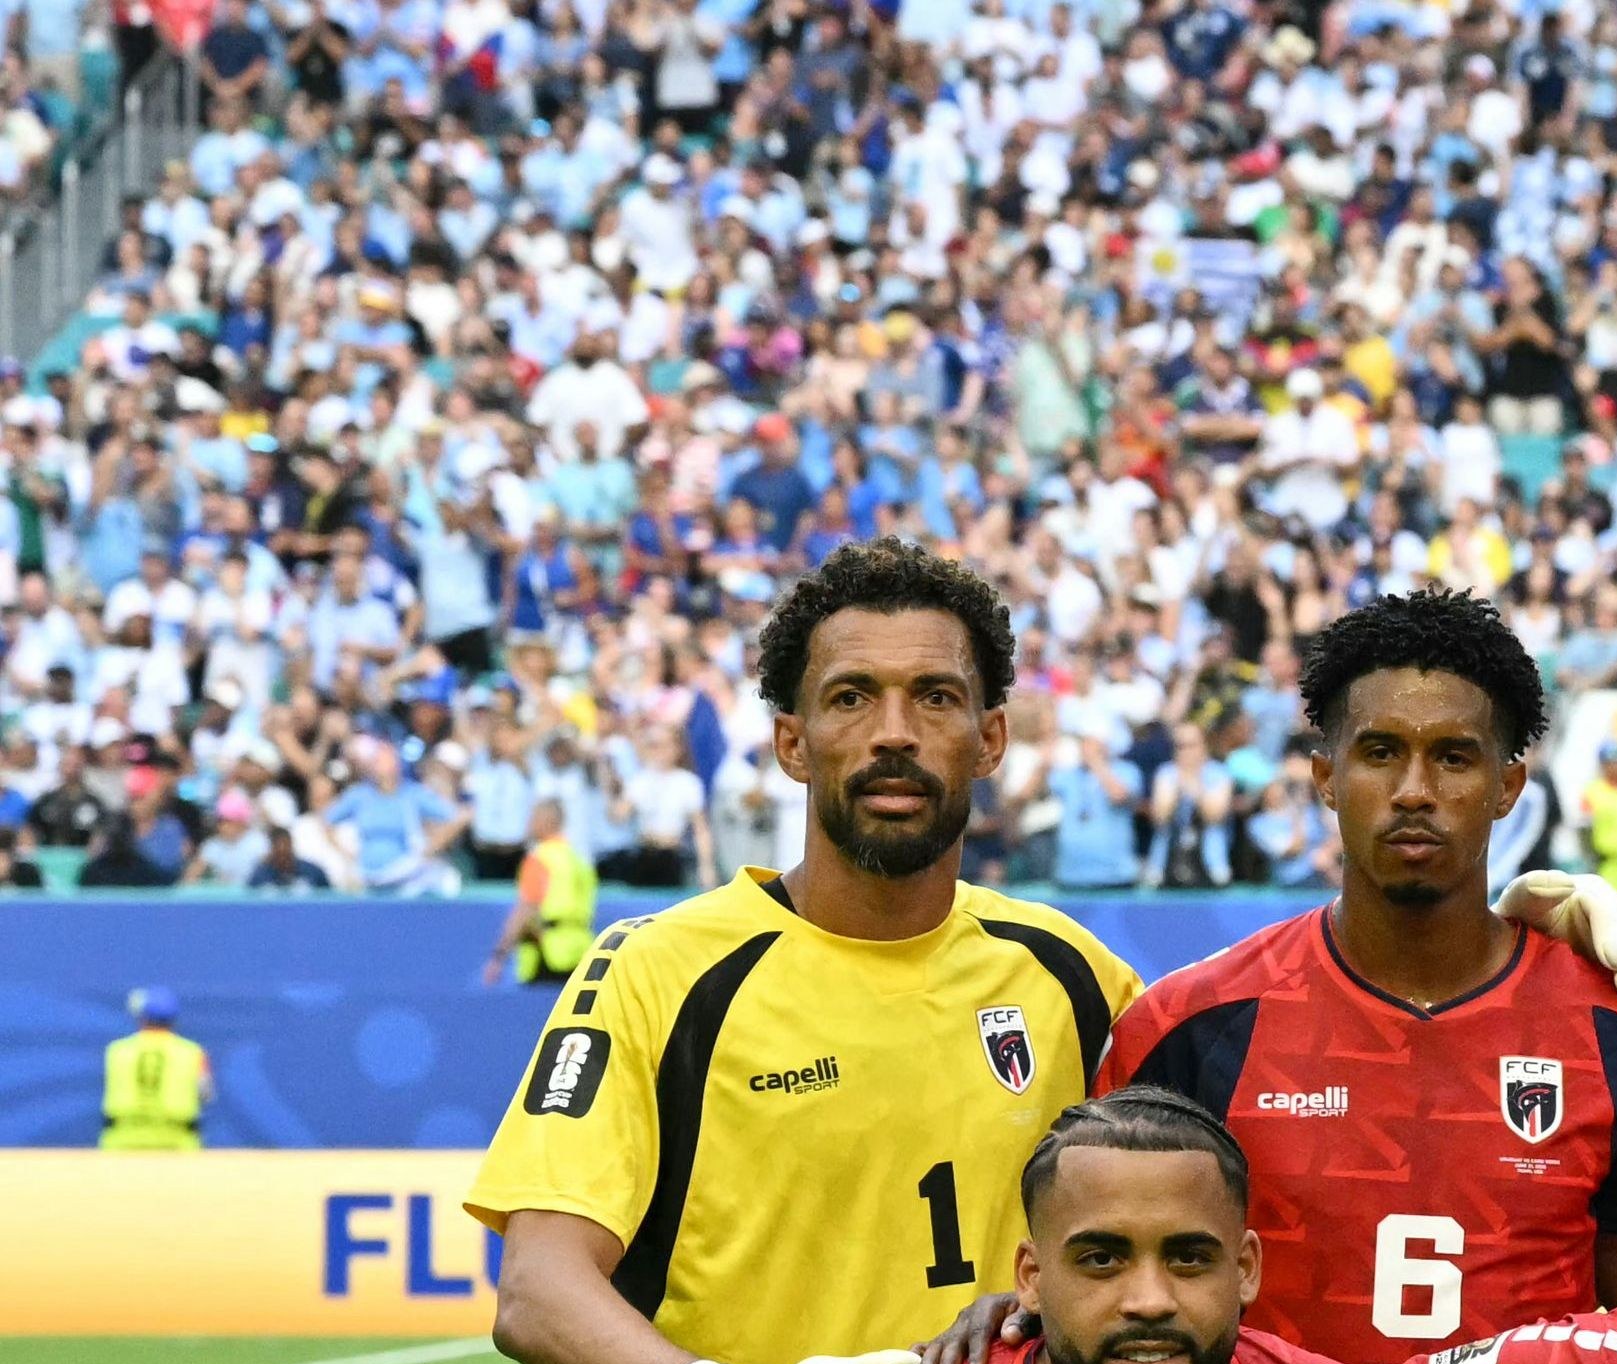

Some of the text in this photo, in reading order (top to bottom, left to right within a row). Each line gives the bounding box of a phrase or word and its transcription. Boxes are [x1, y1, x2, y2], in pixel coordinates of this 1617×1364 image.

[981, 1010, 1019, 1027] FCF
[749, 1055, 840, 1094] capelli
[1506, 1061, 1557, 1075] FCF
[794, 1079, 840, 1095] SPORT
[1256, 1086, 1349, 1115] capelli
[1299, 1108, 1348, 1118] SPORT
[918, 1160, 977, 1289] 1
[324, 1194, 502, 1297] FL
[1371, 1213, 1466, 1340] 6
